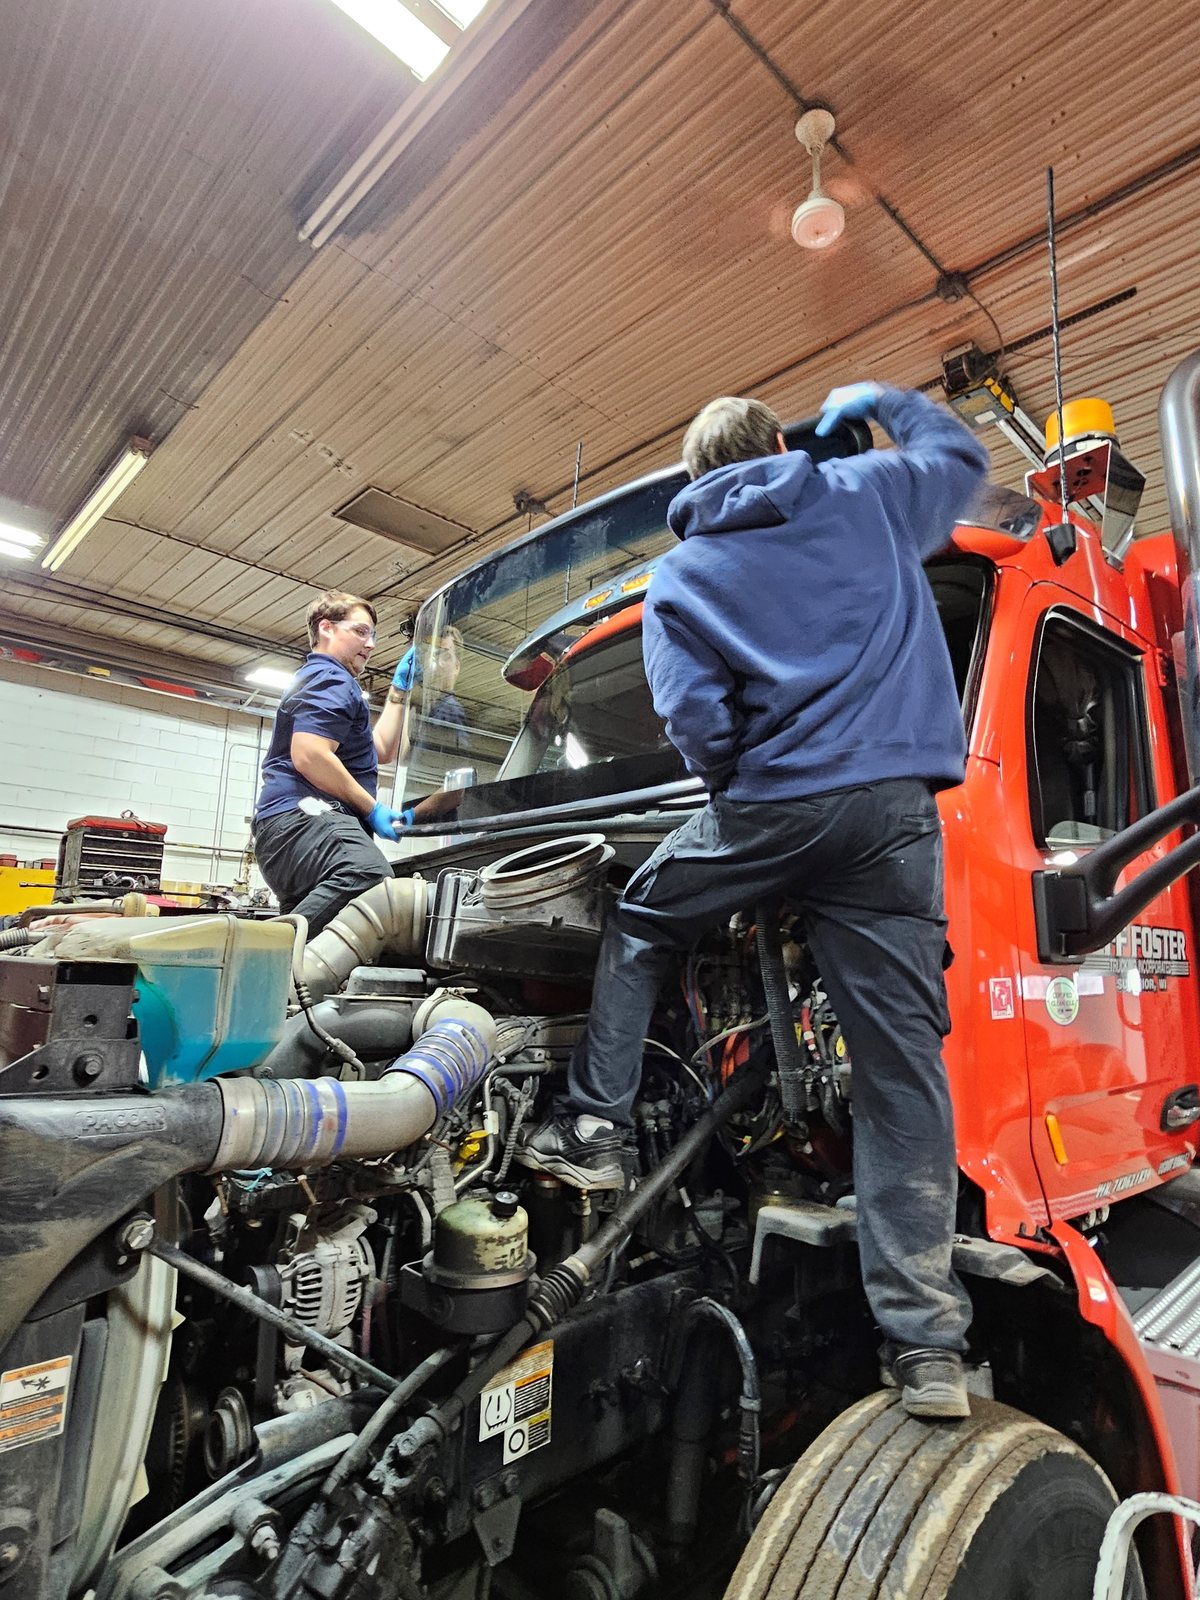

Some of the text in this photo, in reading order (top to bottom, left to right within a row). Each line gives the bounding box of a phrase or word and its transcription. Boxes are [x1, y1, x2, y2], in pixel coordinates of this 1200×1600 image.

[1131, 925, 1187, 961] FOSTER
[1116, 978, 1167, 992] SUIOR, WI
[82, 1108, 165, 1131] PACCAR
